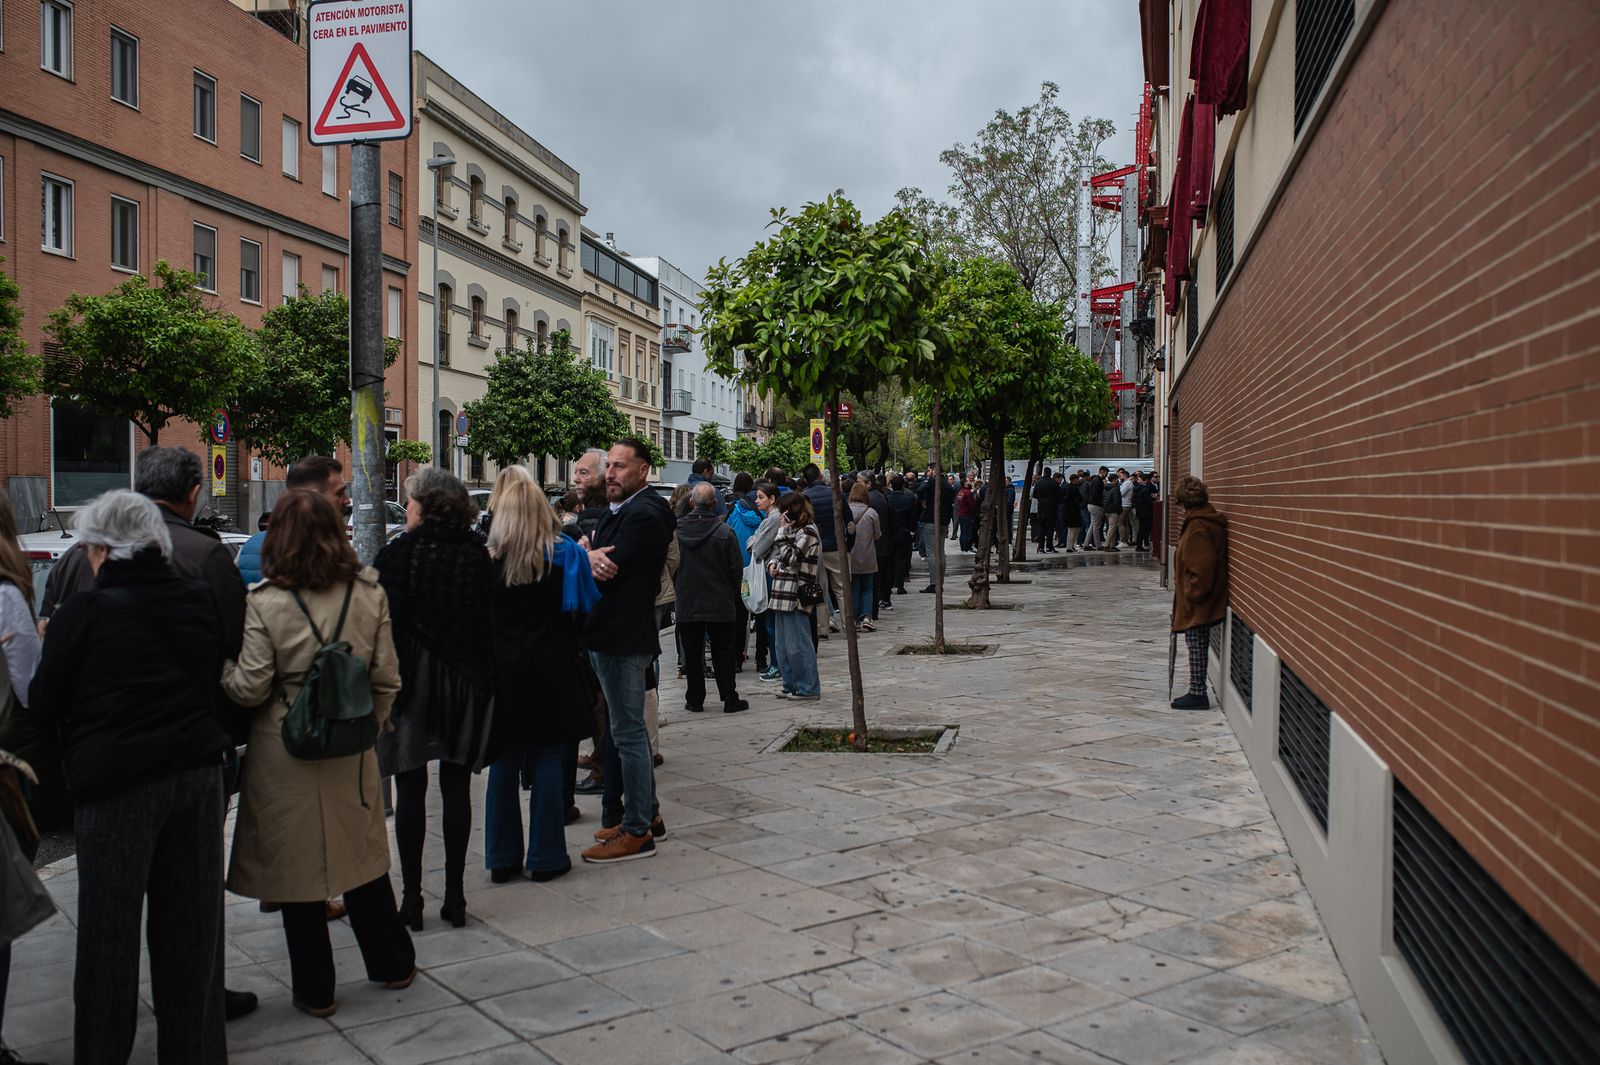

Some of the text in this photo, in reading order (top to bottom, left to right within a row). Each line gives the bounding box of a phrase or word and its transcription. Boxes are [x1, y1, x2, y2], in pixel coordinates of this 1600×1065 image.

[315, 4, 404, 22] ATENCIÓN MOTORISTA
[313, 21, 407, 39] CERA EN EL PAVIMENTO
